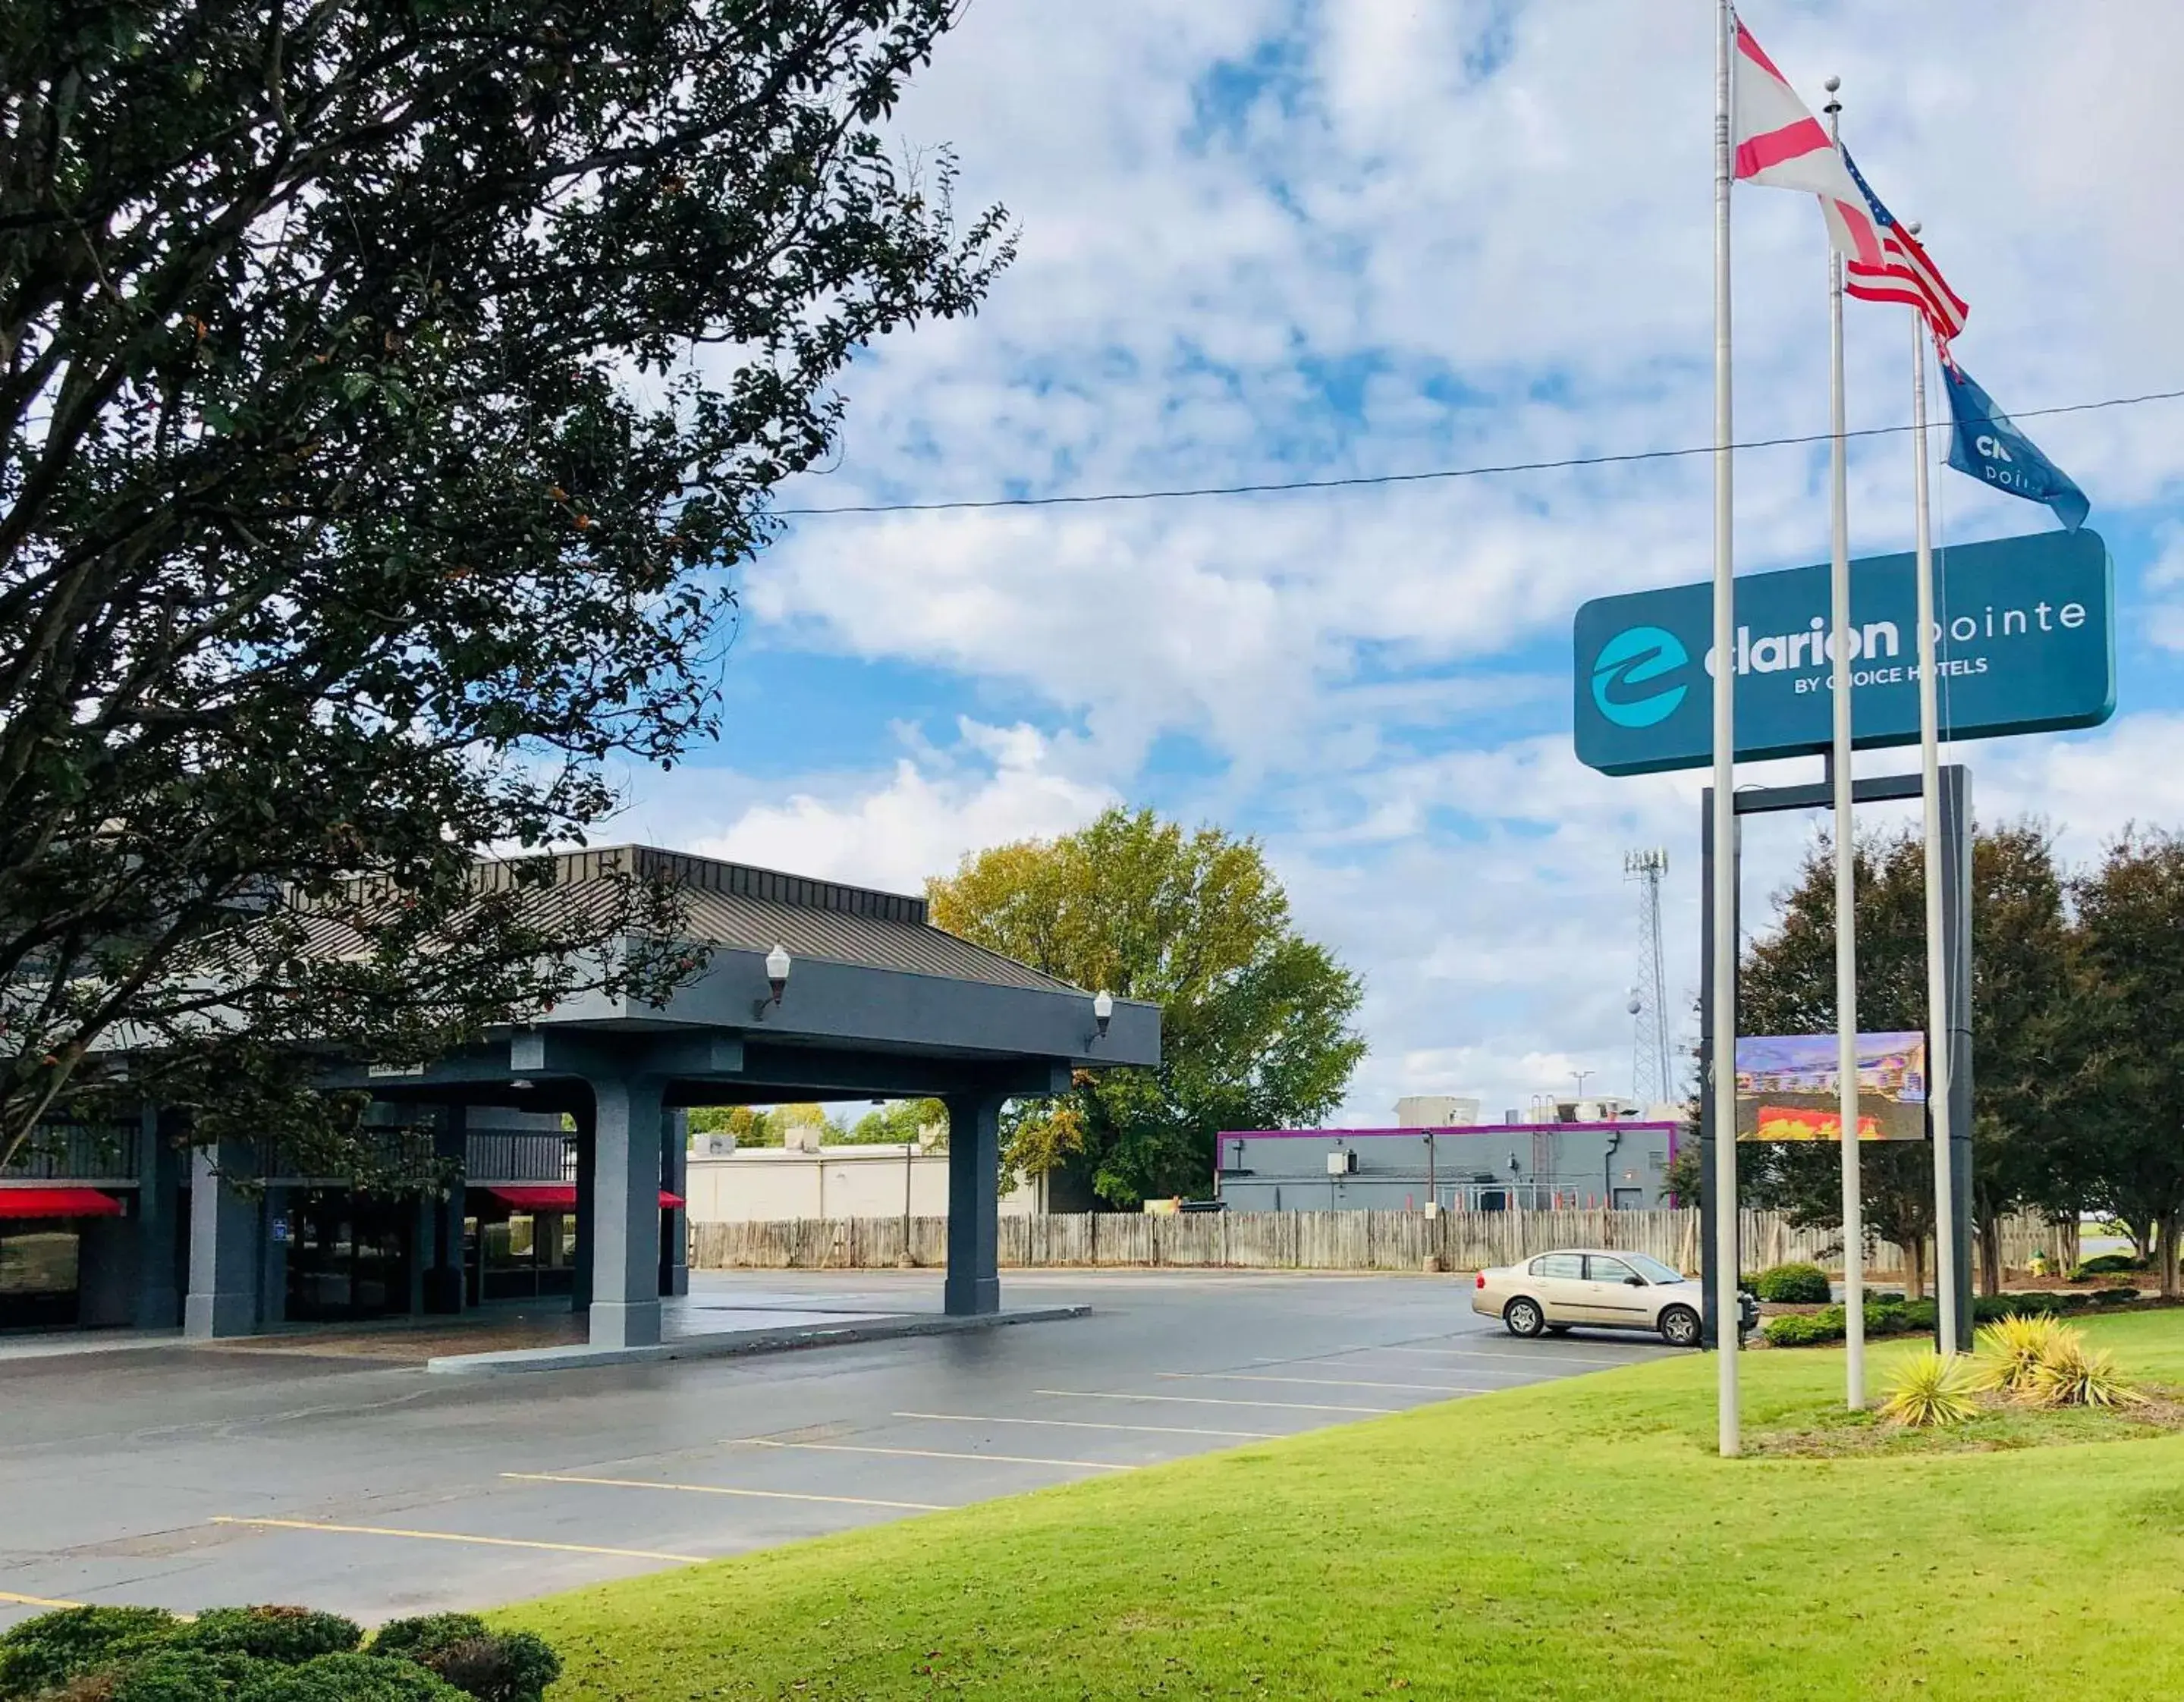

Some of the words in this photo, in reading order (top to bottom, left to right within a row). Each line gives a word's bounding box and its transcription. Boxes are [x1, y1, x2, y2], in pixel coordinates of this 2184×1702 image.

[1794, 677, 1821, 693] BY
[1825, 667, 1903, 689] COICE
[1908, 657, 1988, 681] HTELS
